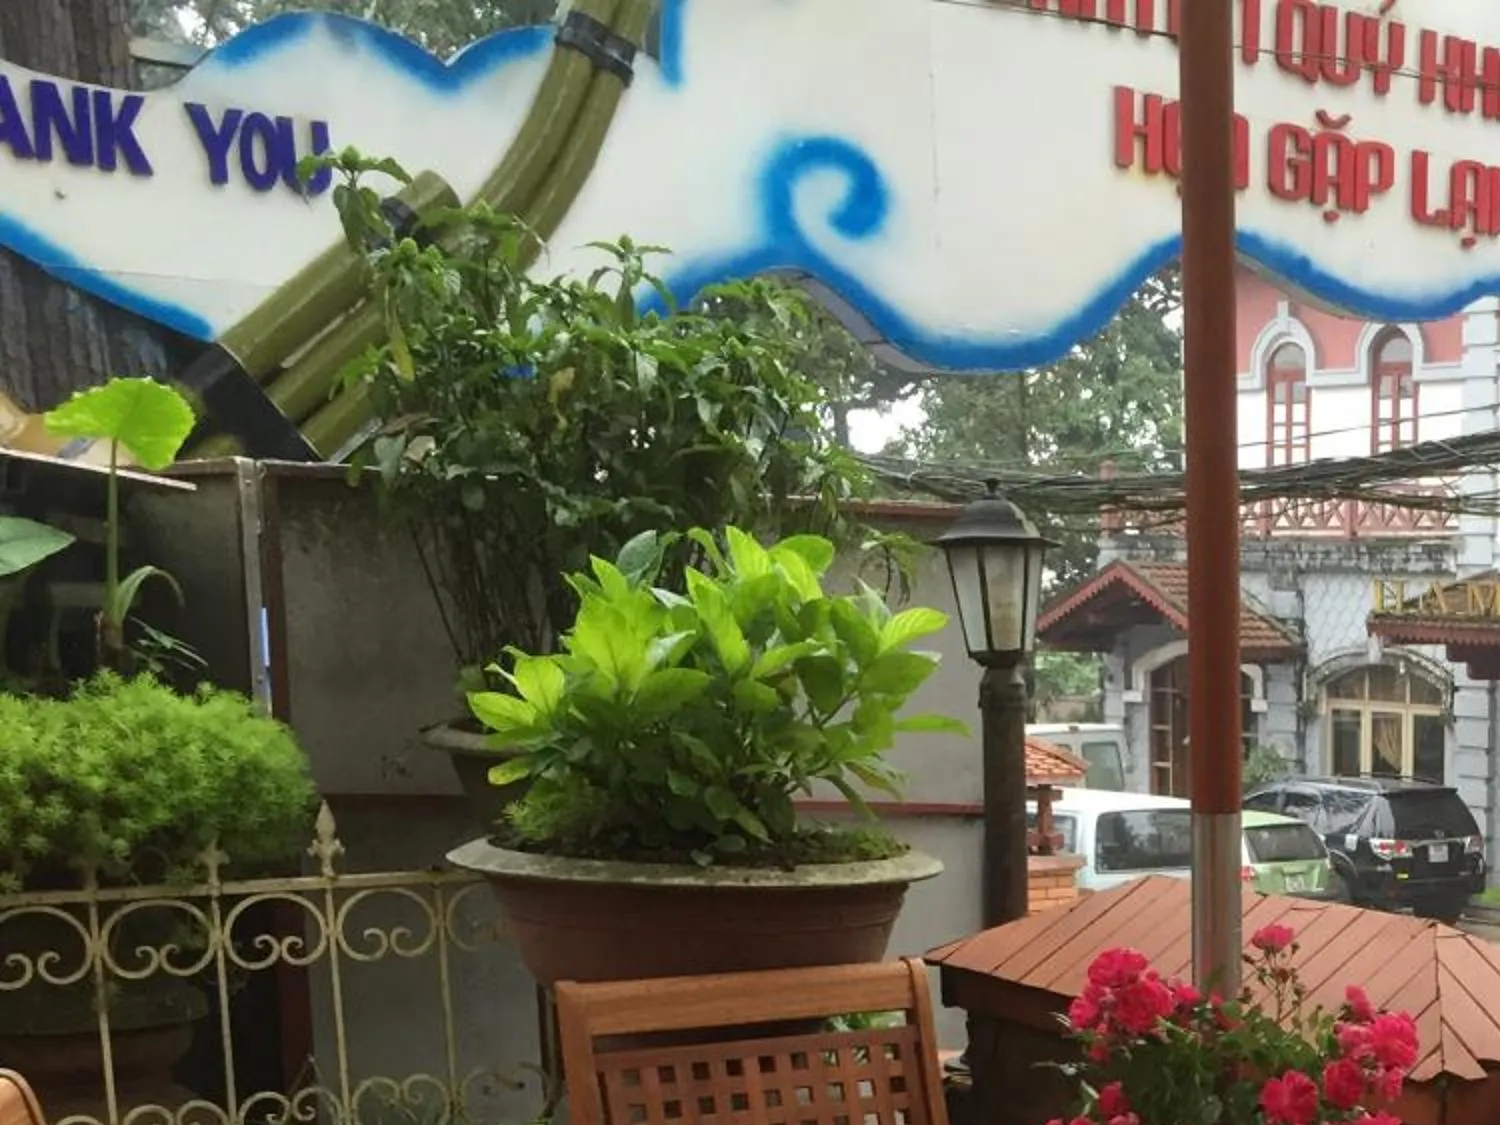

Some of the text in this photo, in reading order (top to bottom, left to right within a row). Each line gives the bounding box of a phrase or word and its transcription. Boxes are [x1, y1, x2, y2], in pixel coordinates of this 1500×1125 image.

[0, 74, 332, 195] ANK YOU
[1267, 109, 1394, 222] GẶP
